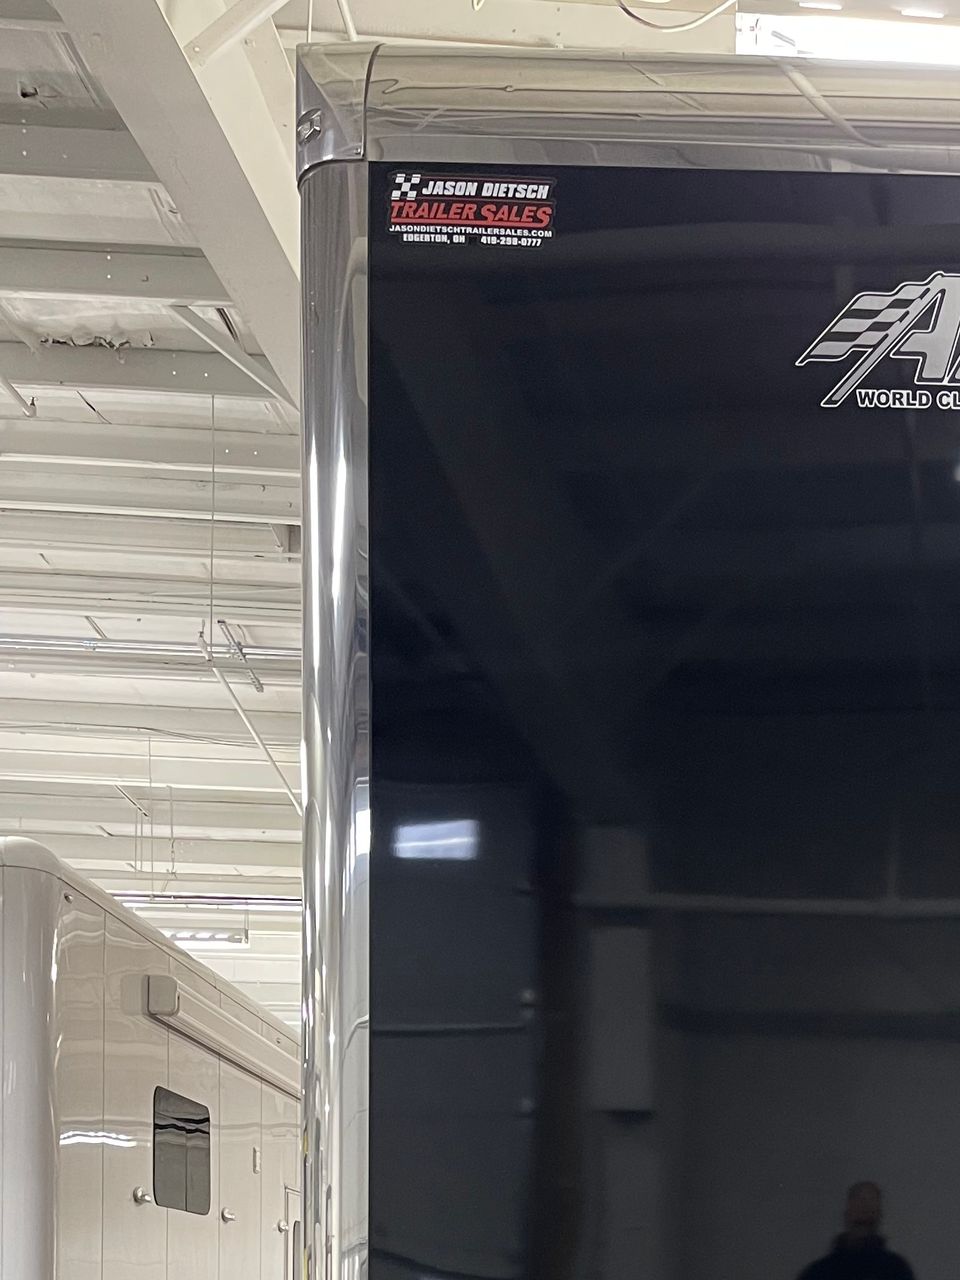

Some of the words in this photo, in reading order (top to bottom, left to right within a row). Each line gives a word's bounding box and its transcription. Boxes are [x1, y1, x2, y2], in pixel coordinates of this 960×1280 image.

[422, 181, 478, 196] JASON
[481, 183, 549, 199] DIETSCH
[391, 201, 477, 219] TRAILER
[480, 204, 552, 227] SALES
[389, 225, 552, 238] JASONDIETSCHTRAILERSALES.COM
[403, 233, 450, 244] EDGERTON,
[453, 235, 466, 244] OH
[856, 389, 932, 409] WORLD
